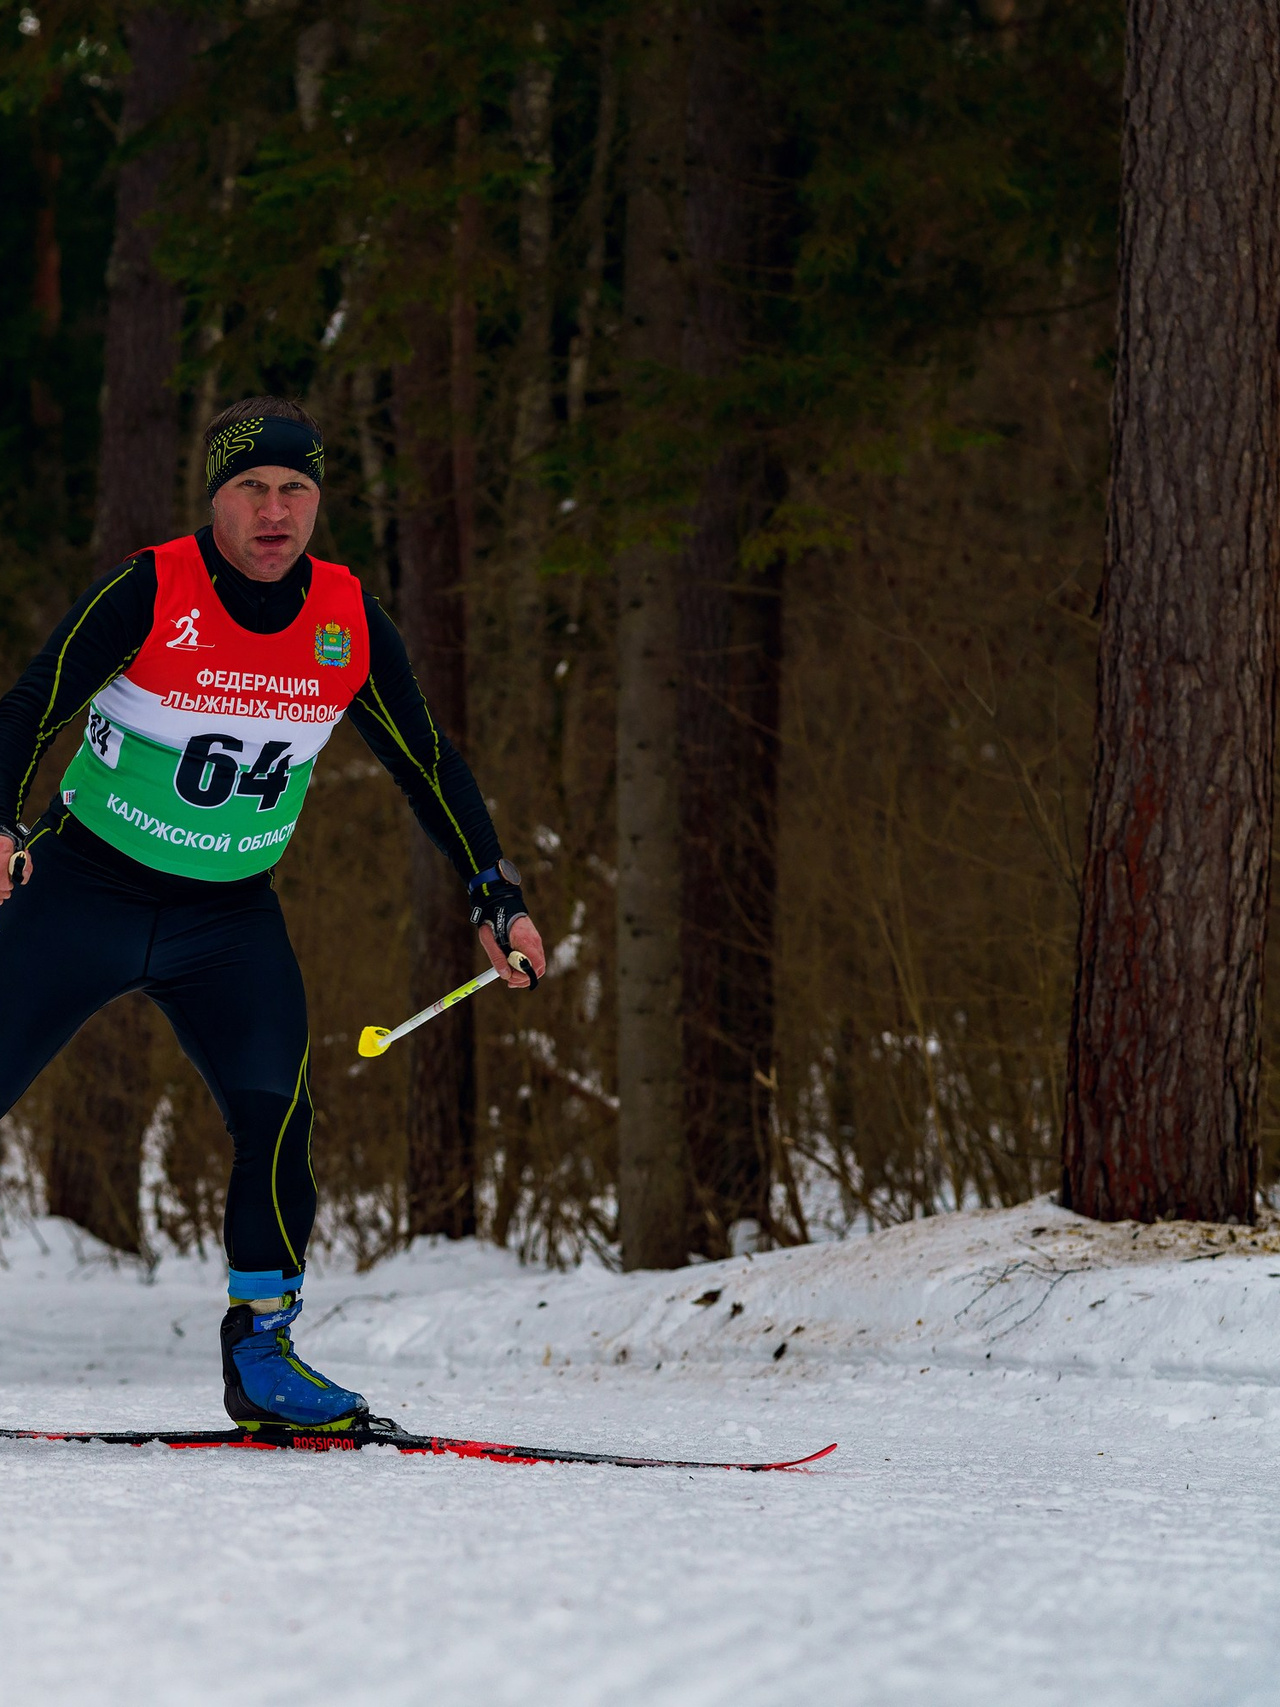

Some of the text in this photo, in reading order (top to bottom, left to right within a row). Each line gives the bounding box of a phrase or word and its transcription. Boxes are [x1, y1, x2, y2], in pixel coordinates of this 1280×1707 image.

[196, 668, 320, 698] ФЕДЕРАЦИЯ
[162, 690, 338, 722] ЛЫЖНЫХ ГОНОК
[174, 733, 293, 812] 64
[107, 793, 232, 852] КАЛУЖСКОЙ
